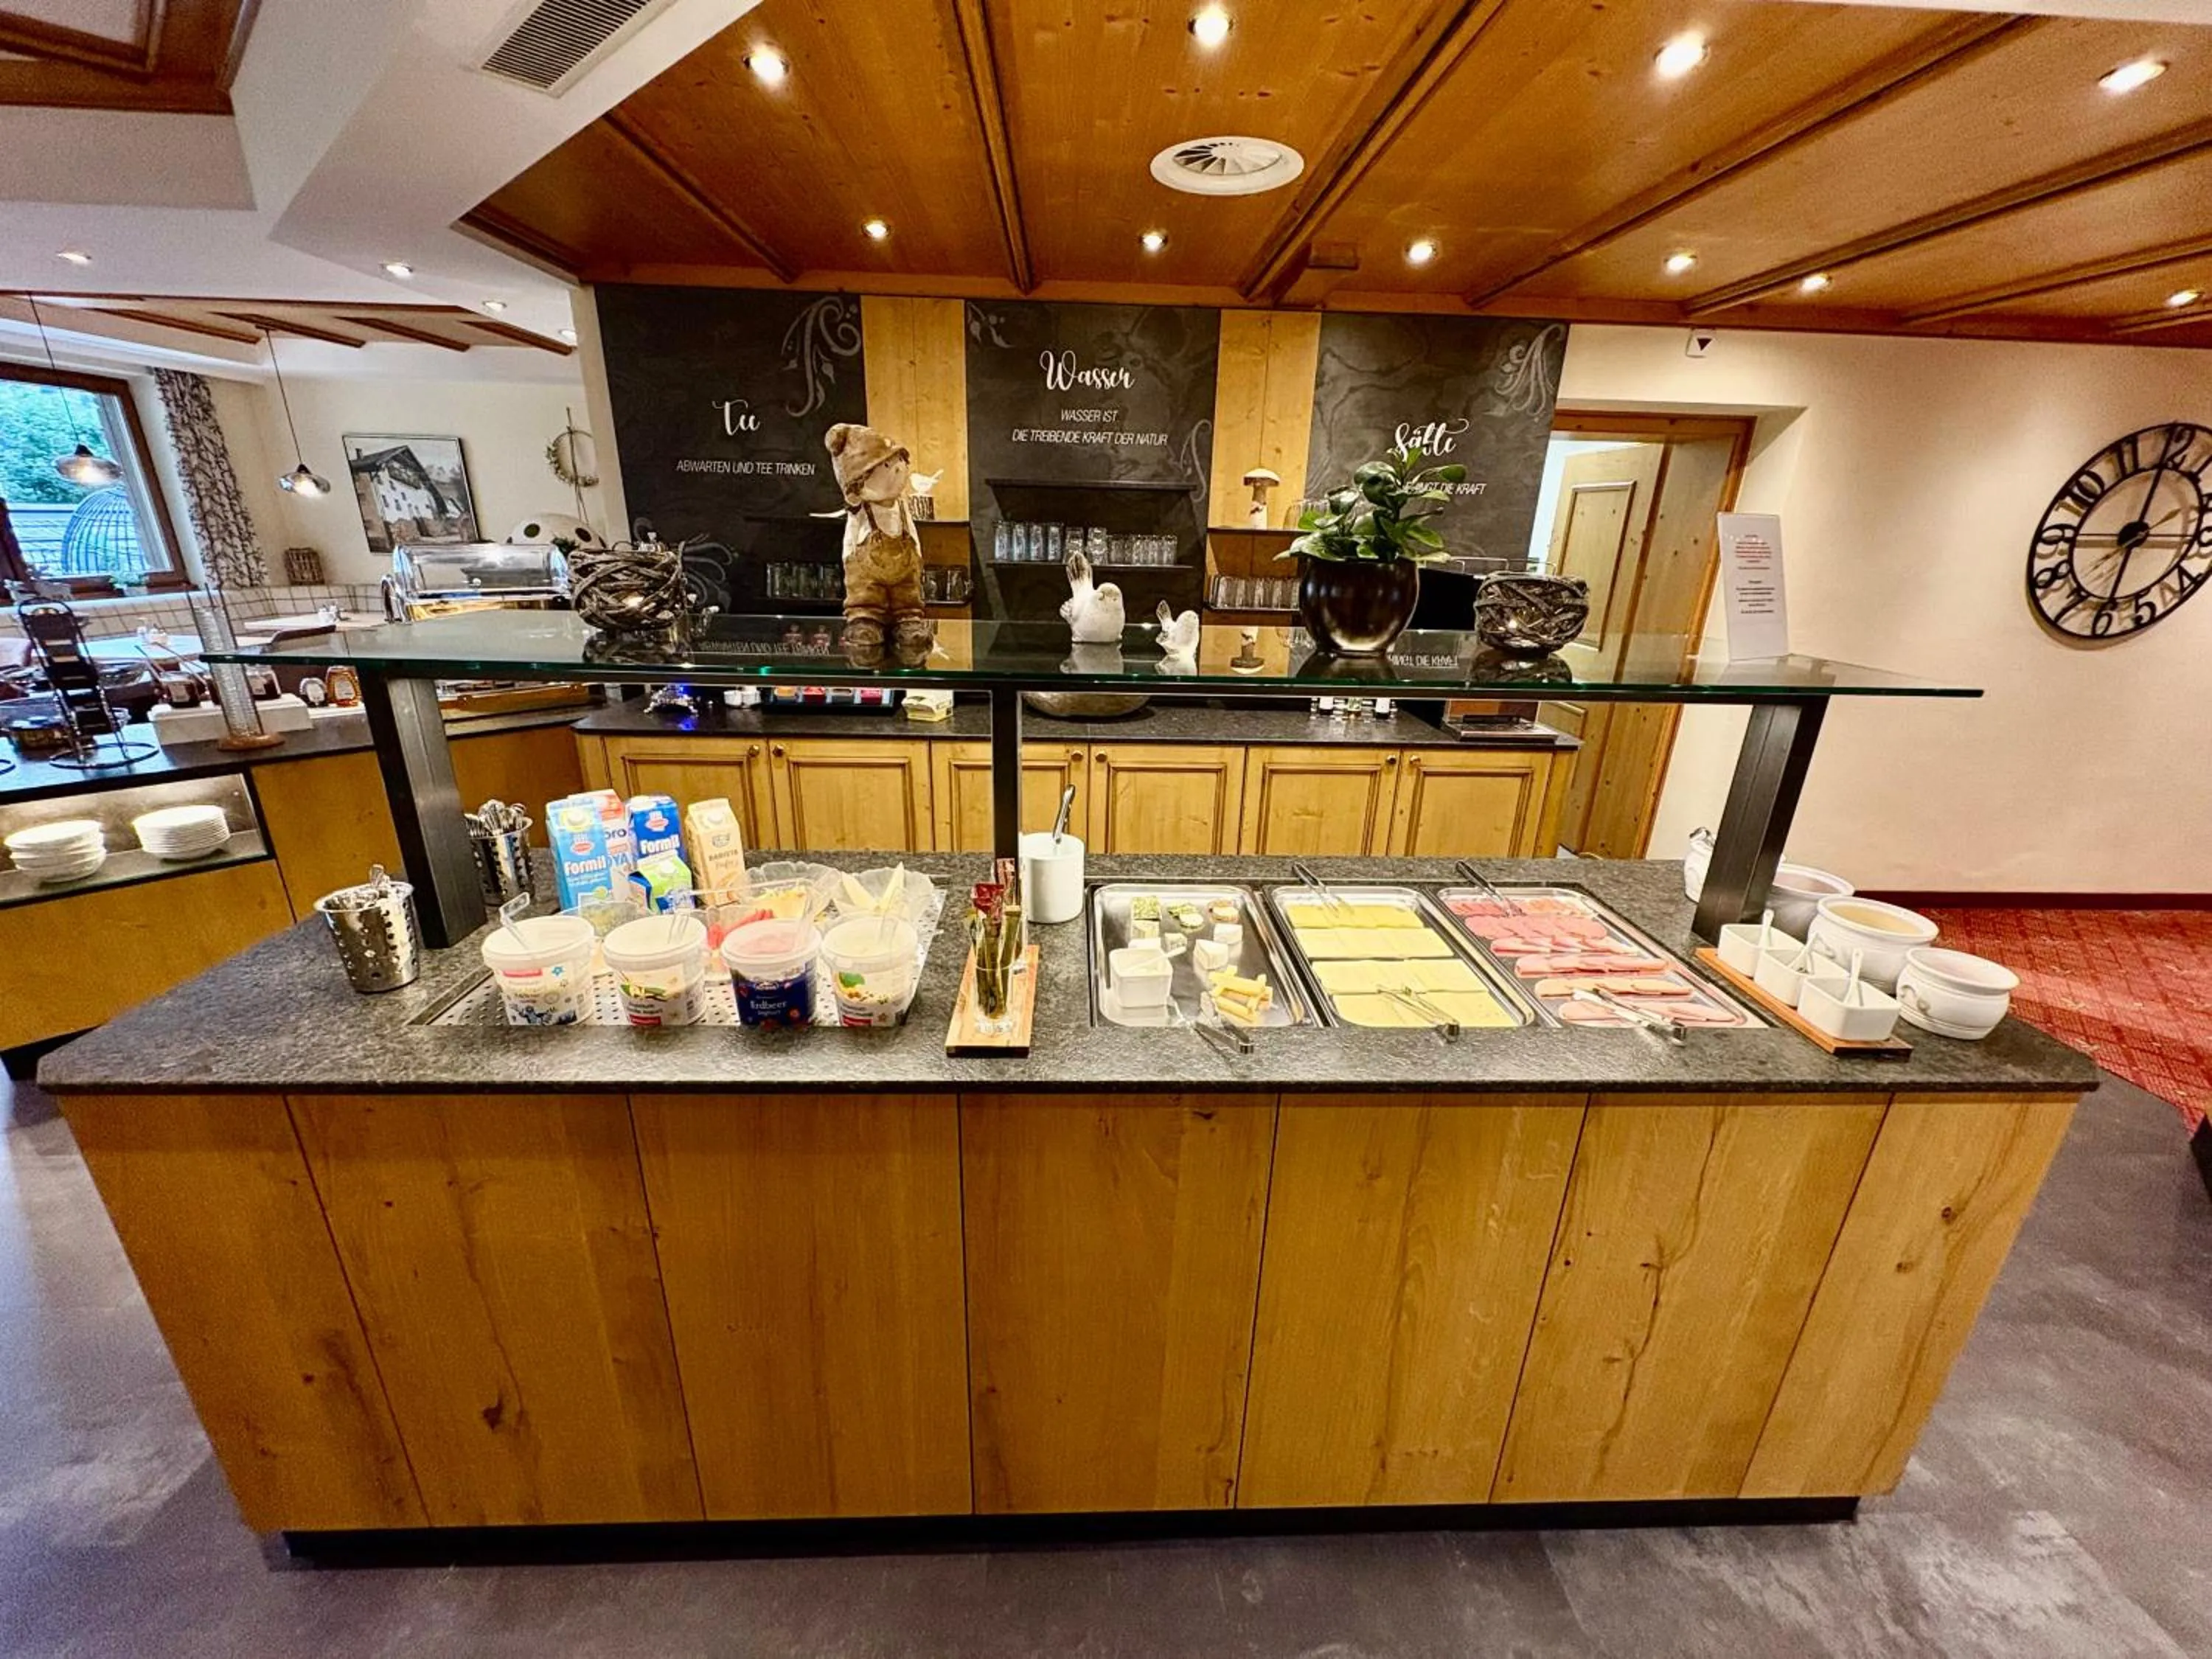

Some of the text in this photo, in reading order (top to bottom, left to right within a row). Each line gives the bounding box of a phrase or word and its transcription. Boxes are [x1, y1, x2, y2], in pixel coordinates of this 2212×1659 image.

[1039, 349, 1135, 391] Wasser
[712, 399, 760, 436] Tee
[1060, 408, 1119, 422] WASSER IST
[1012, 428, 1169, 446] DIE TREIBENDE KRAFT DER NATUR
[675, 459, 816, 476] ABWARTEN UND TEE TRINKEN
[1455, 483, 1488, 495] KRAFT
